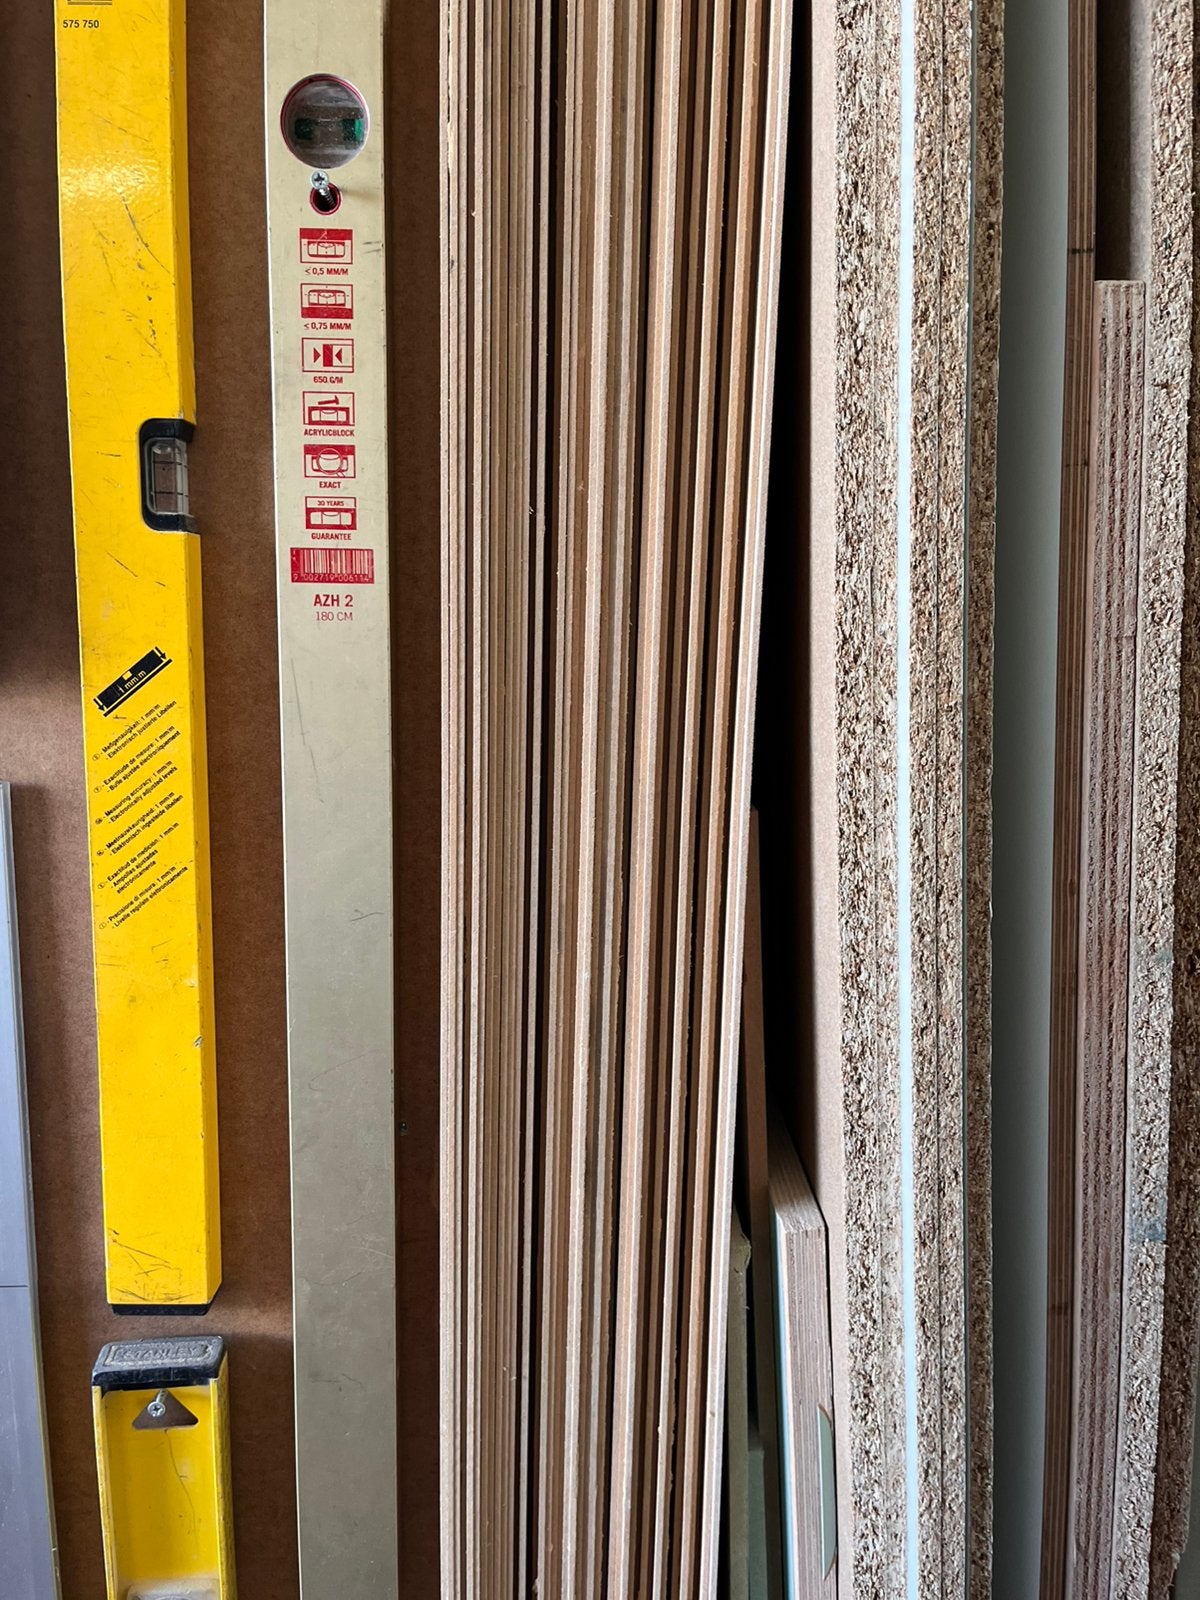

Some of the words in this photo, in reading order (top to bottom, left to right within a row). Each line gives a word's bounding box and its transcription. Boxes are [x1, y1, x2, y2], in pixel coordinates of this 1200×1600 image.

[62, 20, 80, 28] 575
[82, 20, 100, 28] 750
[312, 268, 324, 276] 0,5
[326, 268, 349, 276] MM/M
[311, 322, 328, 330] 0,75
[304, 428, 354, 437] ACRYLICBLOCK
[314, 594, 340, 607] AZH
[345, 594, 353, 607] 2
[316, 612, 334, 621] 180
[337, 612, 353, 621] CM
[110, 795, 142, 822] Electronically
[141, 778, 163, 796] adjusted
[162, 766, 178, 779] levels
[104, 795, 130, 817] Measuring
[122, 1345, 198, 1360] STANLEY
